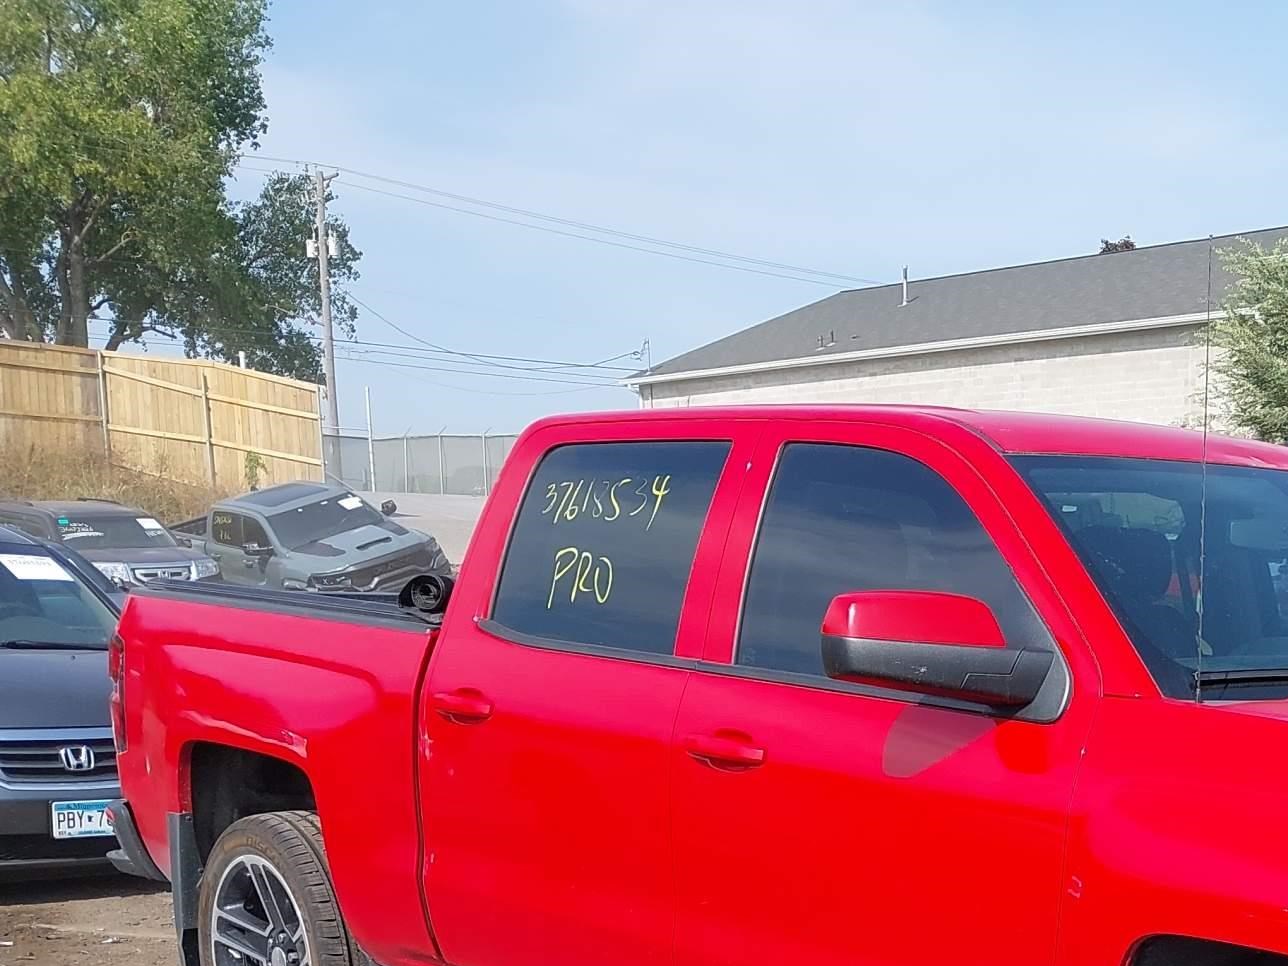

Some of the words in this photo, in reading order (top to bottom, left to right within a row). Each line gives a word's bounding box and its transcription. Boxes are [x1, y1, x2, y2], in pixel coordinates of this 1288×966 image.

[542, 475, 670, 531] 37618534
[547, 547, 613, 609] PRO
[57, 811, 85, 829] PBY
